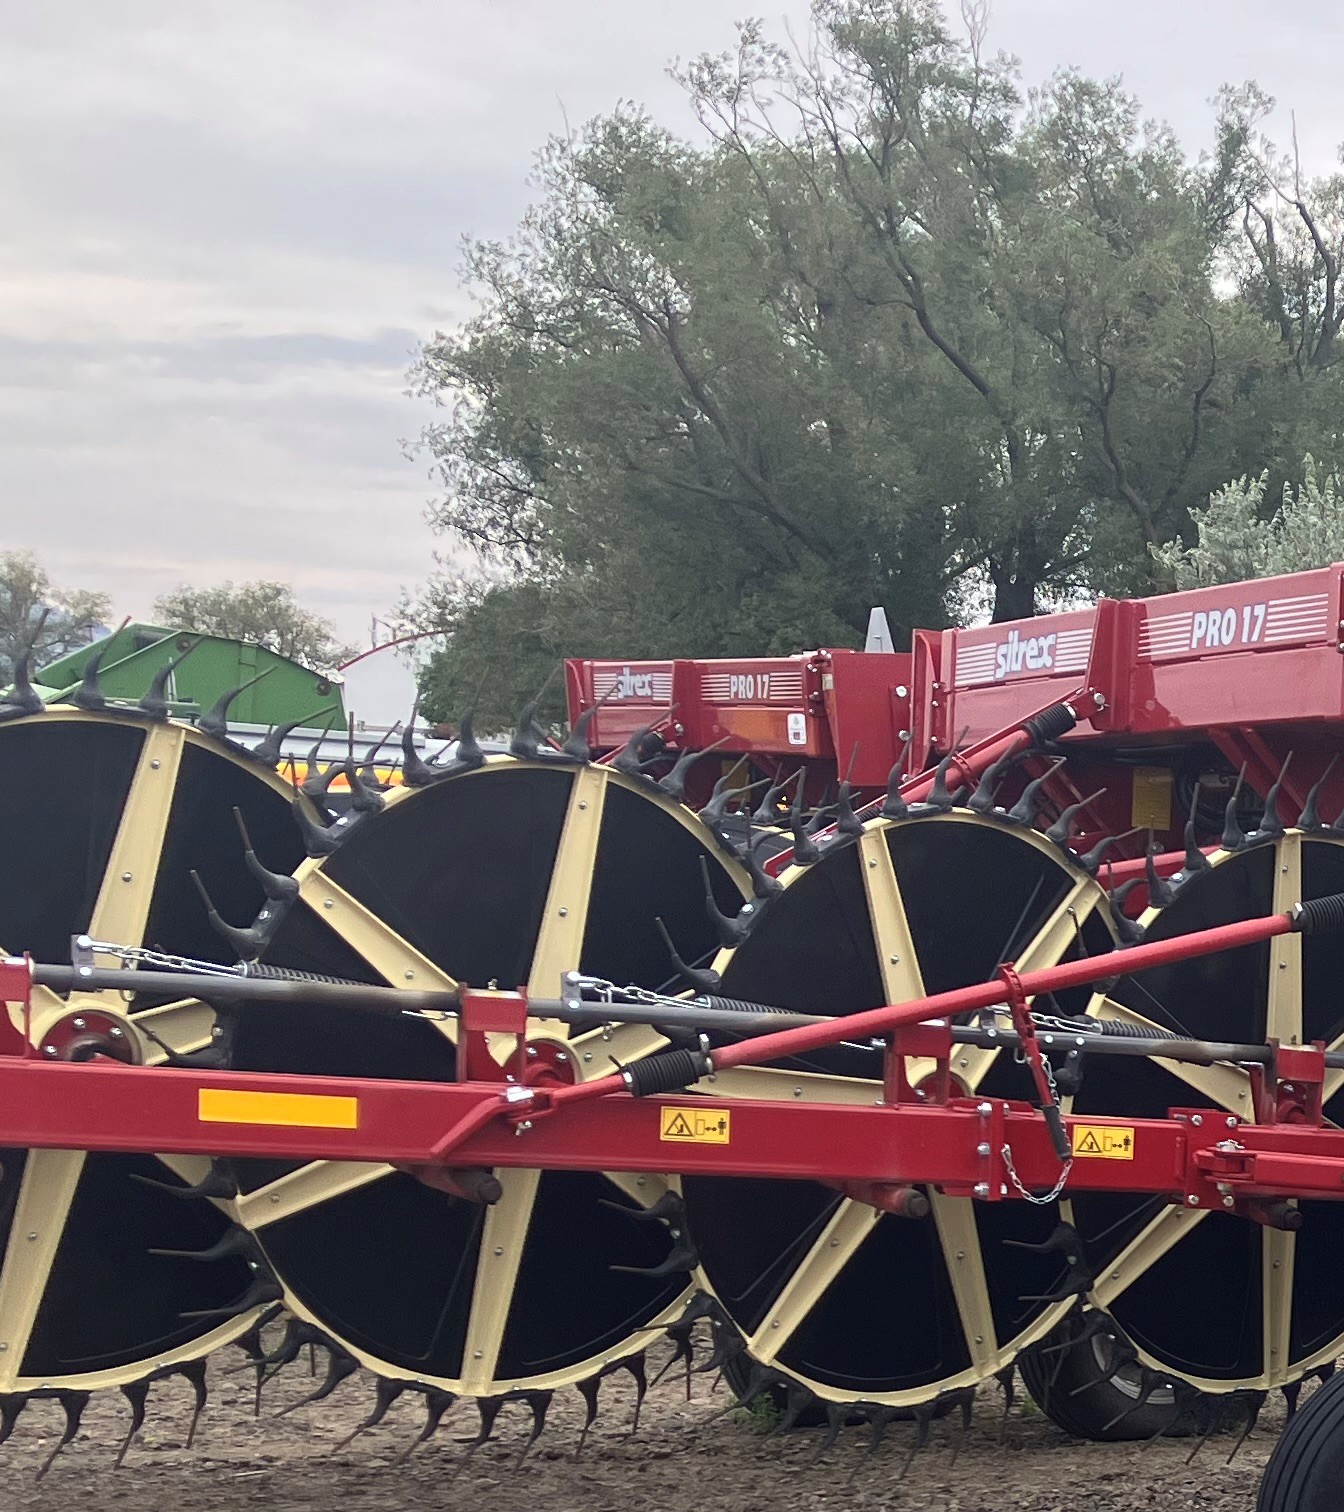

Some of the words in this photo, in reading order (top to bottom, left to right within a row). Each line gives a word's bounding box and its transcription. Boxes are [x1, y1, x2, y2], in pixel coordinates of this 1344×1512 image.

[1191, 607, 1236, 649] PRO
[1241, 604, 1266, 643] 17
[994, 630, 1056, 679] sitrex
[730, 674, 754, 699] PRO
[756, 674, 769, 699] 17
